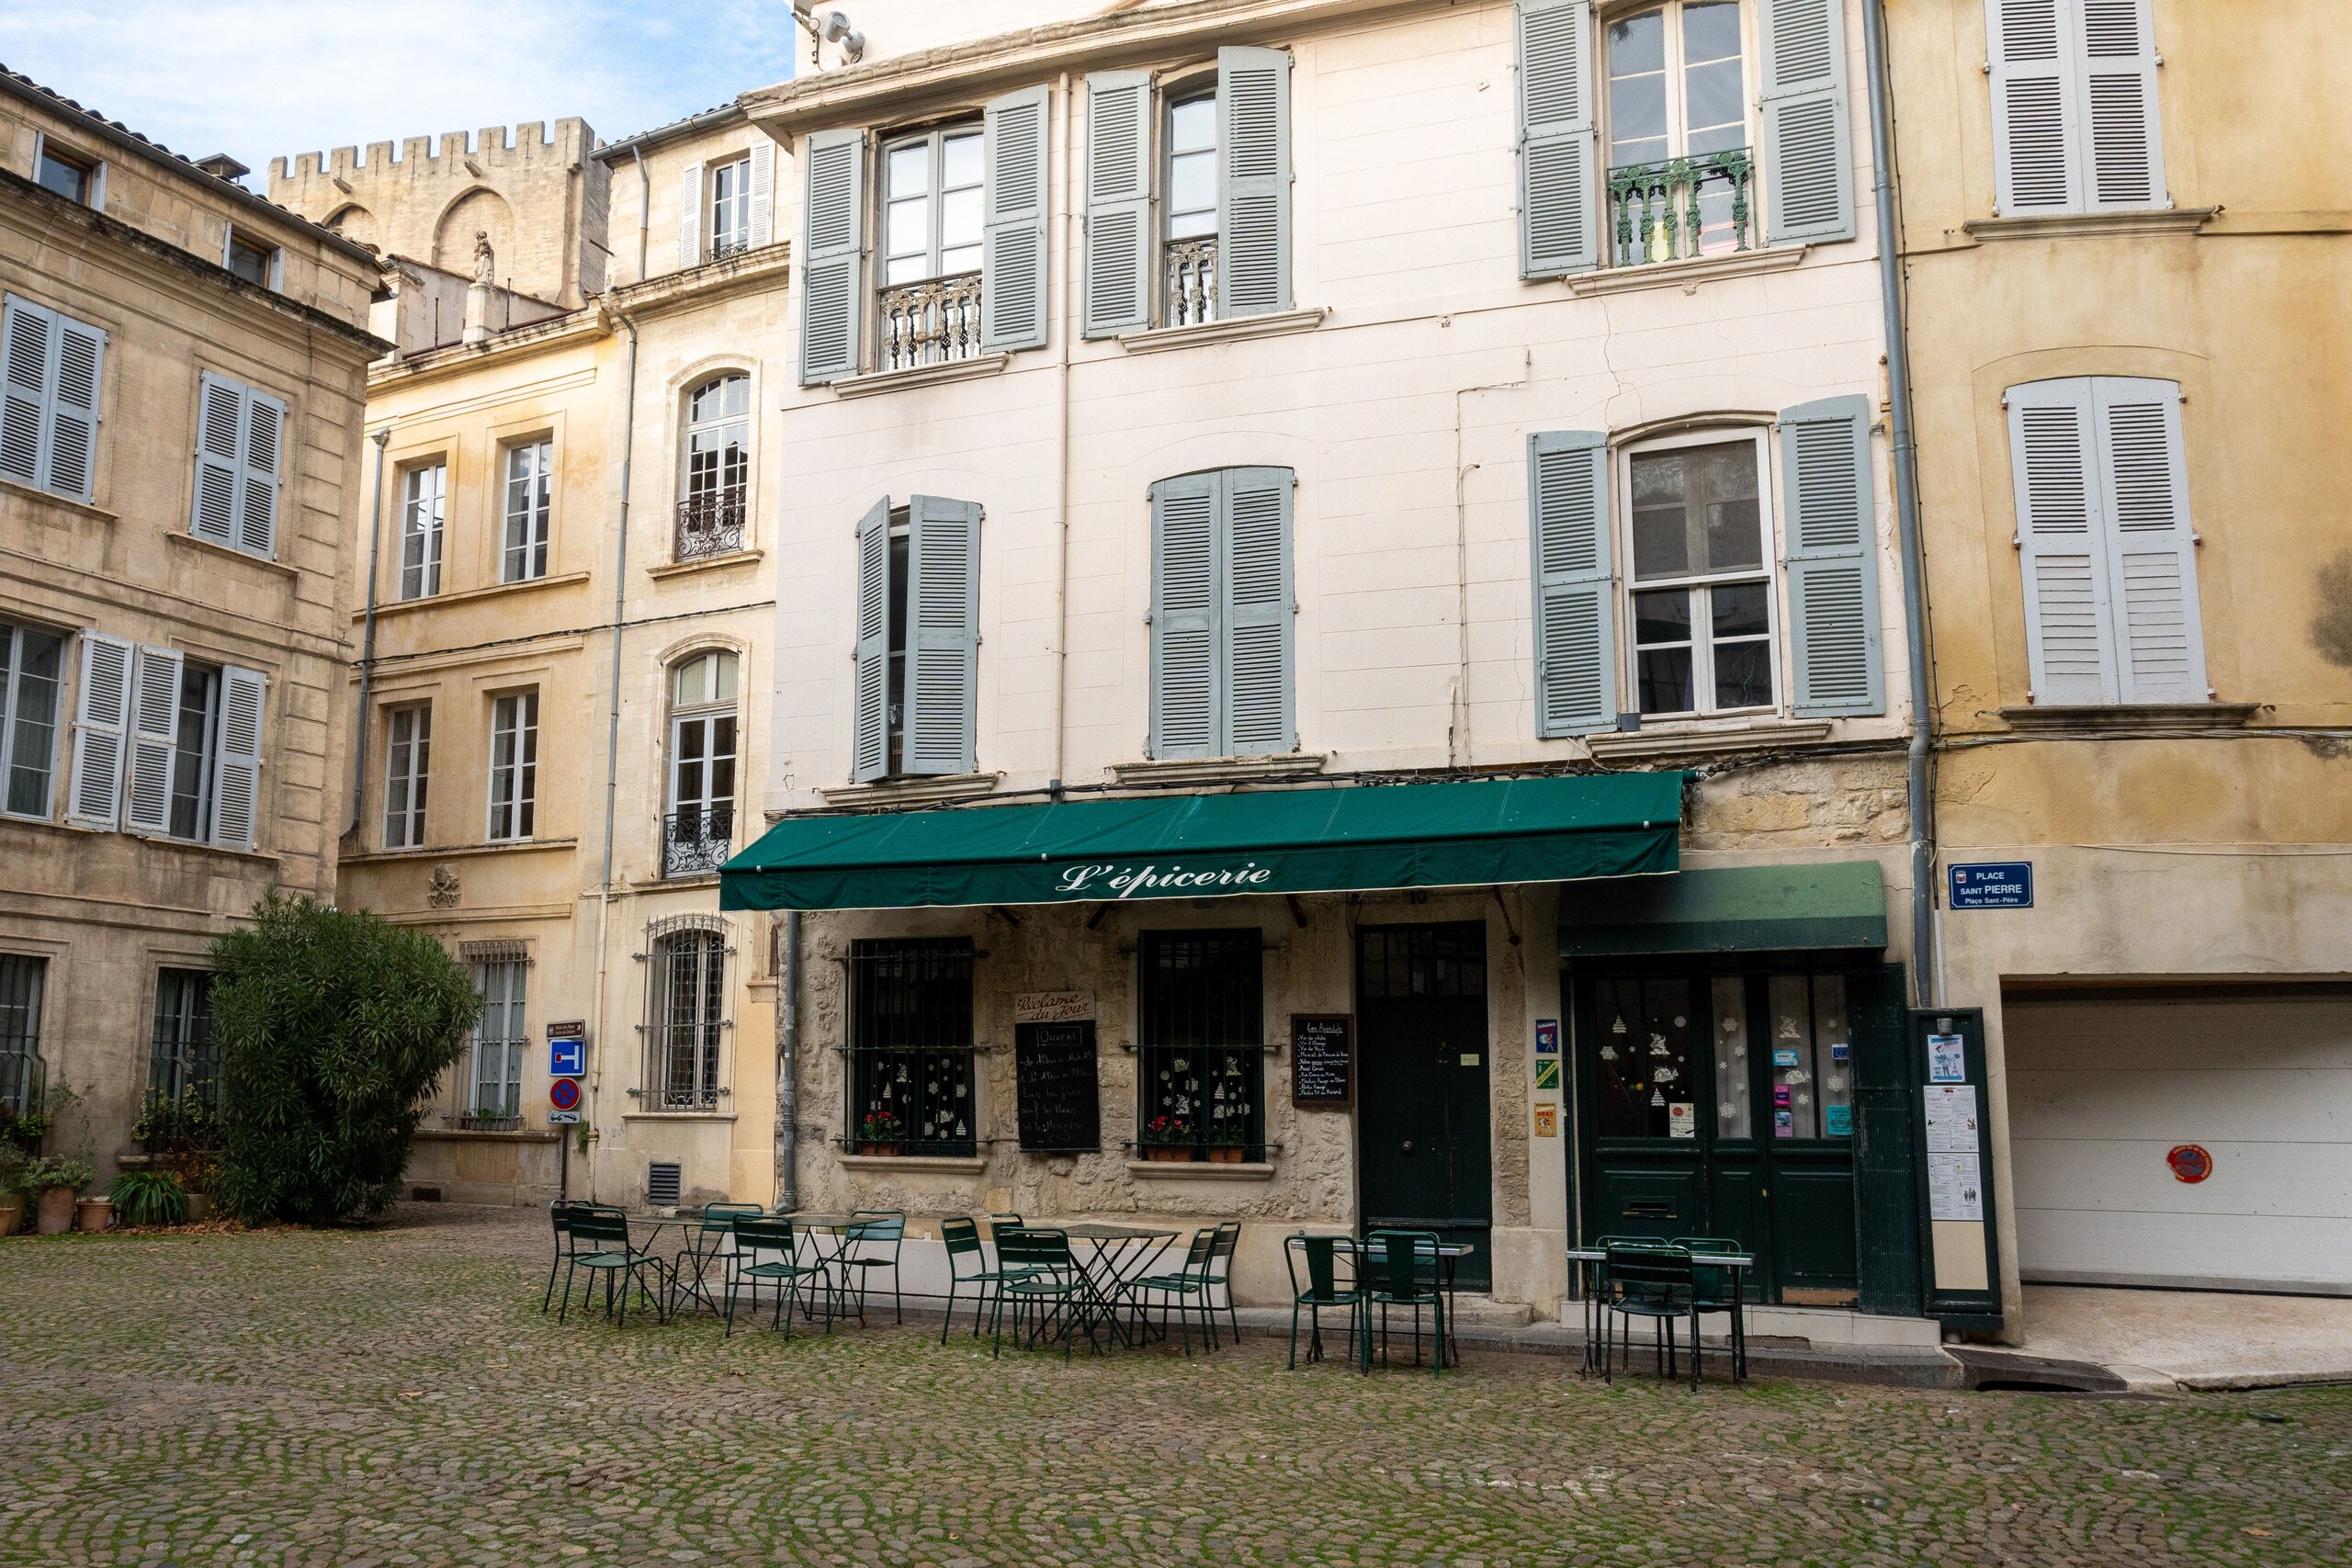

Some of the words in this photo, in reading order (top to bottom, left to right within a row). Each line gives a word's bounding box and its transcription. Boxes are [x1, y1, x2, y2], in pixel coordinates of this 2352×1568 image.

[1056, 863, 1271, 898] L'épicerie
[1976, 872, 2005, 880] PLACE
[1984, 885, 2022, 894] PIERRE
[1018, 993, 1085, 1010] Réclame
[1028, 1009, 1049, 1021] du
[1053, 1002, 1090, 1021] Jour
[1537, 1062, 1557, 1084] RESTAURANT
